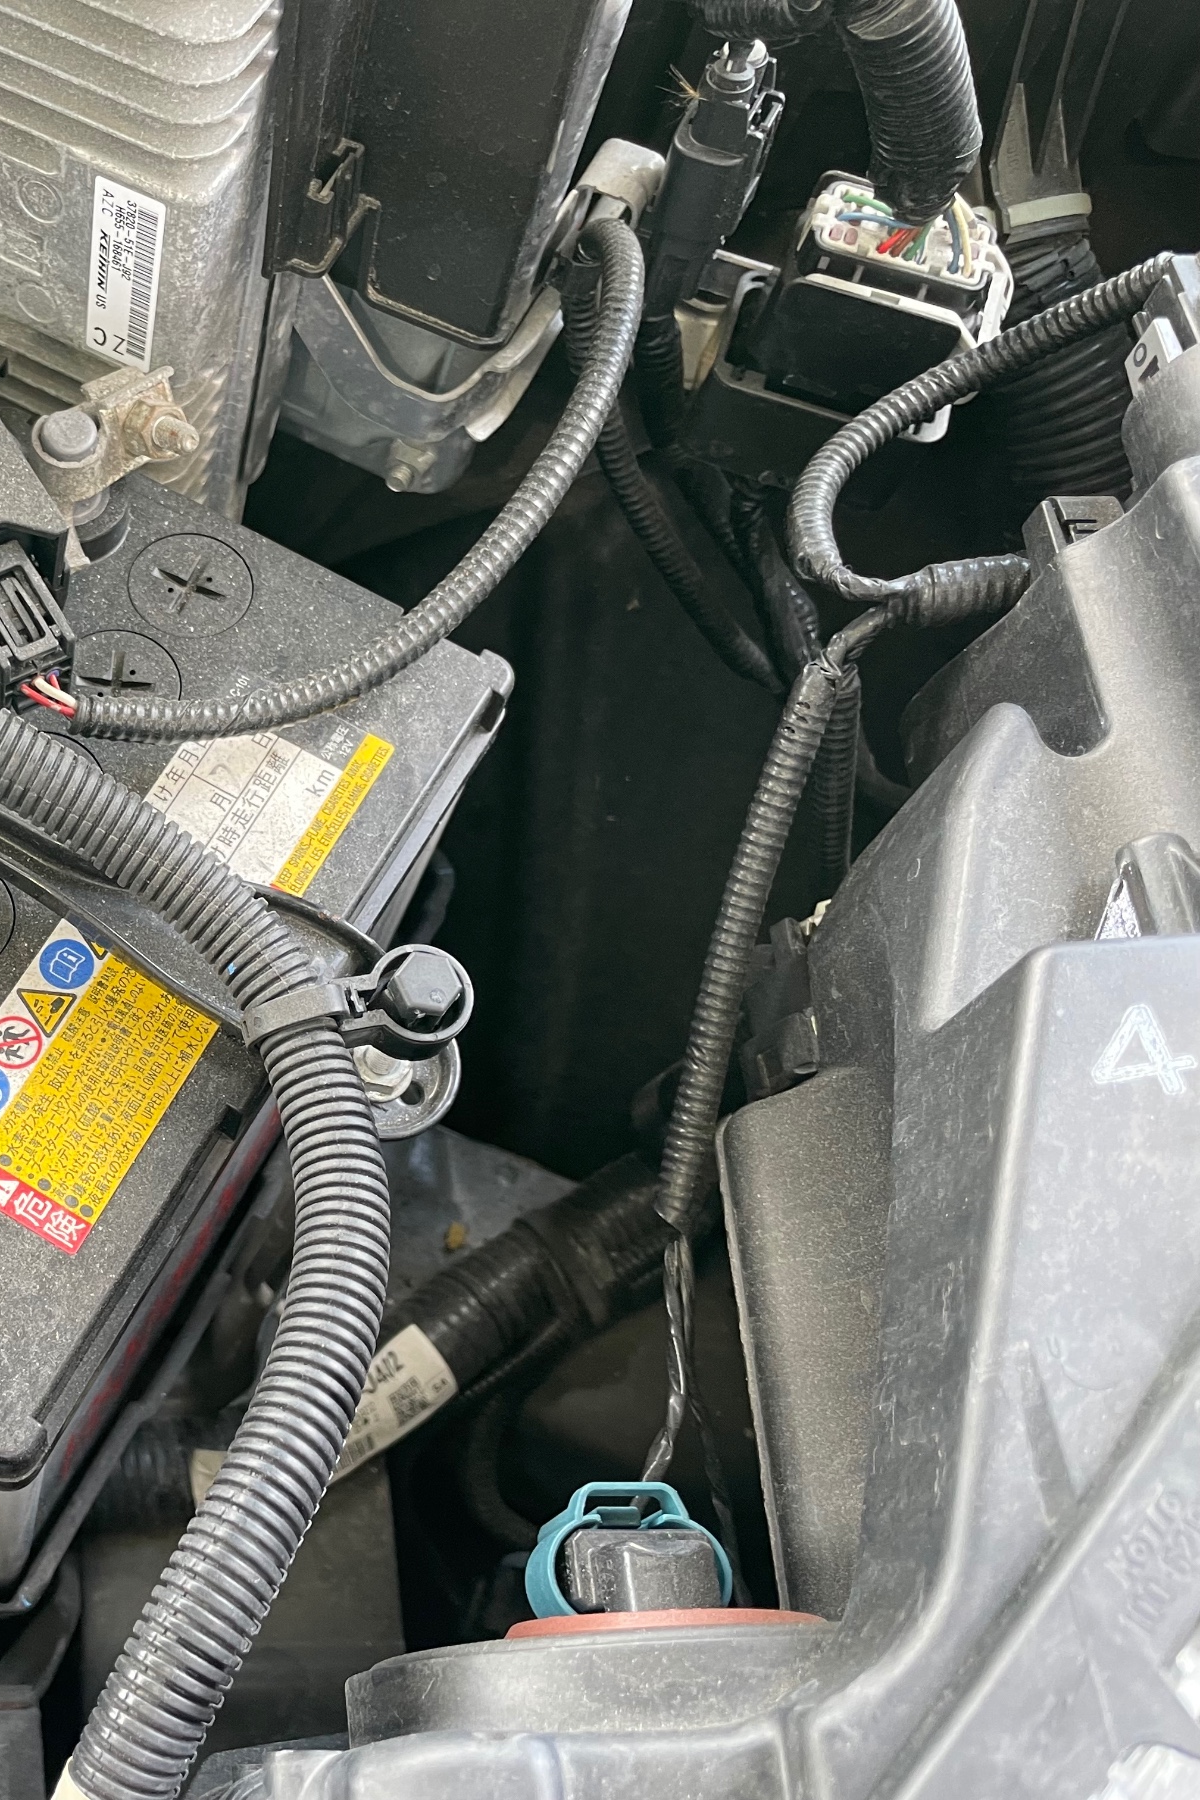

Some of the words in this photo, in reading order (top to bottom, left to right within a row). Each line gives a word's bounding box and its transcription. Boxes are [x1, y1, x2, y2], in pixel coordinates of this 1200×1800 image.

[101, 188, 114, 218] AZC
[110, 204, 125, 272] H655-168461
[120, 199, 136, 281] 37820-51E-J92
[96, 228, 111, 294] KEIHIN
[95, 293, 106, 309] US
[337, 737, 356, 758] 12V
[305, 765, 335, 798] km
[275, 866, 294, 886] KEEP
[320, 777, 351, 816] CIGARETTES
[309, 845, 324, 862] LES
[1092, 1004, 1197, 1095] 4
[138, 1059, 166, 1092] LOWER
[139, 1090, 165, 1120] UPPER
[8, 1184, 88, 1250] 危険
